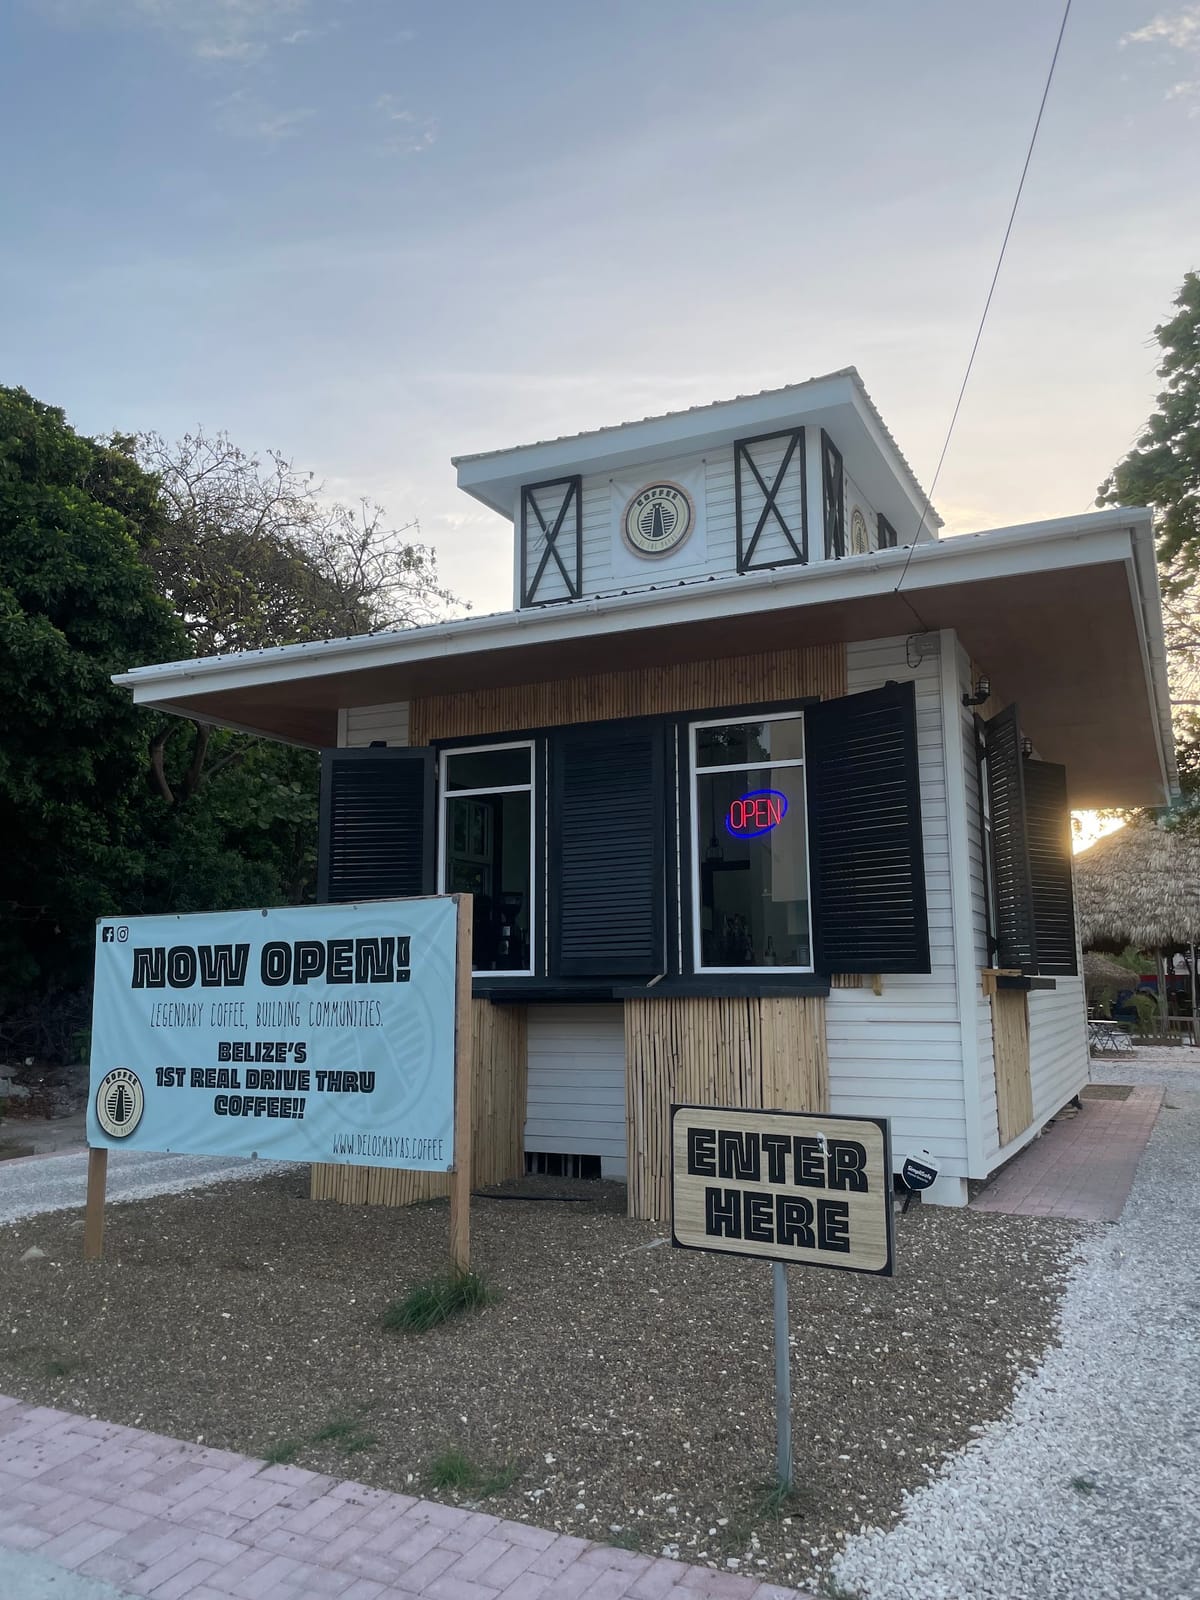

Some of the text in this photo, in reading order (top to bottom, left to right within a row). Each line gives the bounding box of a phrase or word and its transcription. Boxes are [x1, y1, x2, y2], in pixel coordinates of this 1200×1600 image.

[636, 489, 678, 507] COFFEE
[730, 798, 781, 829] OPEN
[131, 936, 411, 988] NOW OPEN!
[150, 1000, 384, 1030] LEGENDARY COFFEE, BUILDING COMMUNITIES.
[217, 1041, 307, 1063] BELIZE'S
[105, 1071, 138, 1086] COFFEE
[155, 1067, 376, 1094] 1ST REAL DRIVE THRU
[213, 1094, 307, 1119] COFFEE!!
[332, 1133, 444, 1161] WWW.DELOSMAYAS.COFFEE
[687, 1127, 869, 1193] ENTER
[705, 1186, 850, 1253] HERE
